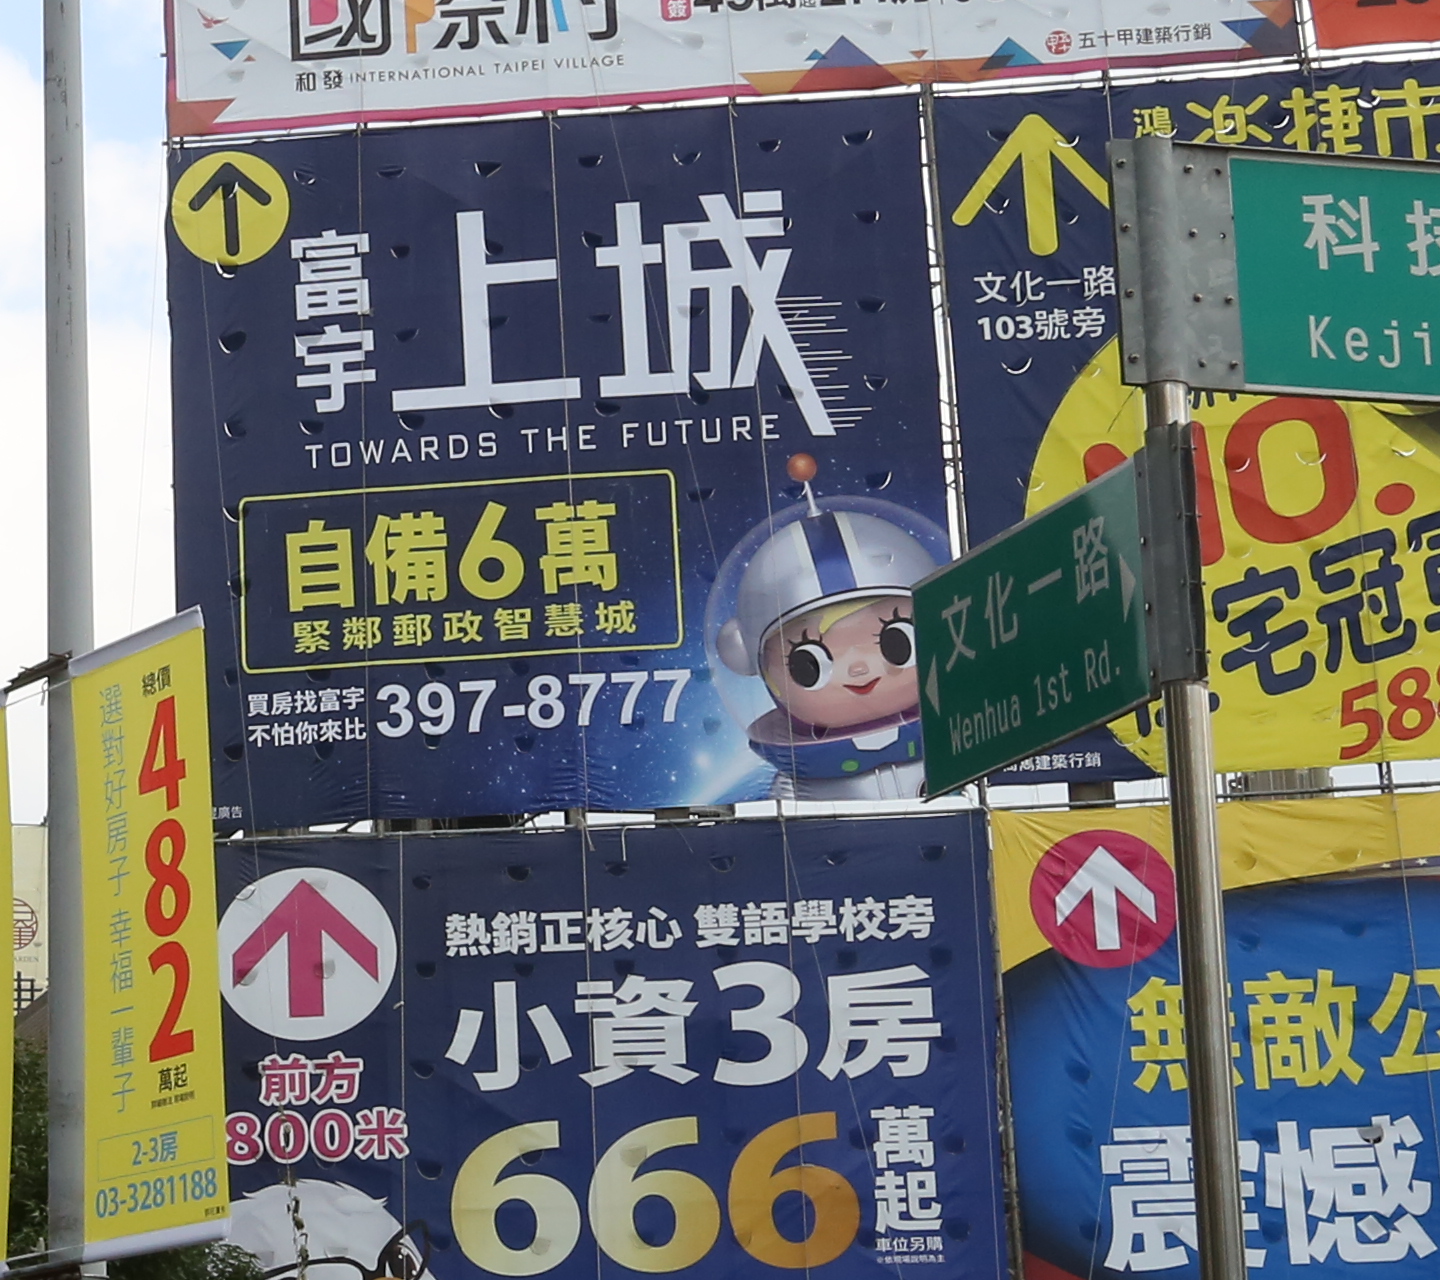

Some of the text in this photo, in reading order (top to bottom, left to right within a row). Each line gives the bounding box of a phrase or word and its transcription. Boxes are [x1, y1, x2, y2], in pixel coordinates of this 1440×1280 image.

[1077, 23, 1213, 50] 五十甲建築行銷
[295, 54, 625, 93] 和發 INTERNATIONAL TAIPEI VILLAGE
[391, 190, 837, 437] 上城
[974, 266, 1117, 306] 文化一路
[290, 230, 376, 414] 富宇
[977, 306, 1107, 342] 103號旁
[1308, 315, 1432, 370] Keji
[305, 415, 781, 470] TOWARDS THE FUTURE
[285, 500, 618, 613] 自備6萬
[941, 516, 1110, 672] 文化一路
[293, 600, 637, 655] 緊鄰郵政智慧城
[142, 664, 171, 698] 總價
[248, 686, 366, 717] 買房找富宇
[375, 669, 692, 739] 397-8777
[949, 640, 1121, 755] Wenhua 1st Rd.
[248, 718, 367, 748] 不怕你來比
[100, 683, 136, 1114] 選對好房子 幸福一輩子
[138, 695, 195, 1063] 482
[445, 894, 934, 959] 熱銷正核心 雙語學校旁
[445, 960, 942, 1093] 小資3房
[157, 1063, 189, 1095] 萬起
[259, 1053, 363, 1106] 前方
[132, 1130, 178, 1167] 2-3房
[226, 1106, 409, 1166] 800米
[96, 1167, 218, 1218] 03-3281188
[451, 1110, 860, 1276] 666
[870, 1104, 943, 1232] 萬起
[875, 1235, 944, 1253] 車位另購
